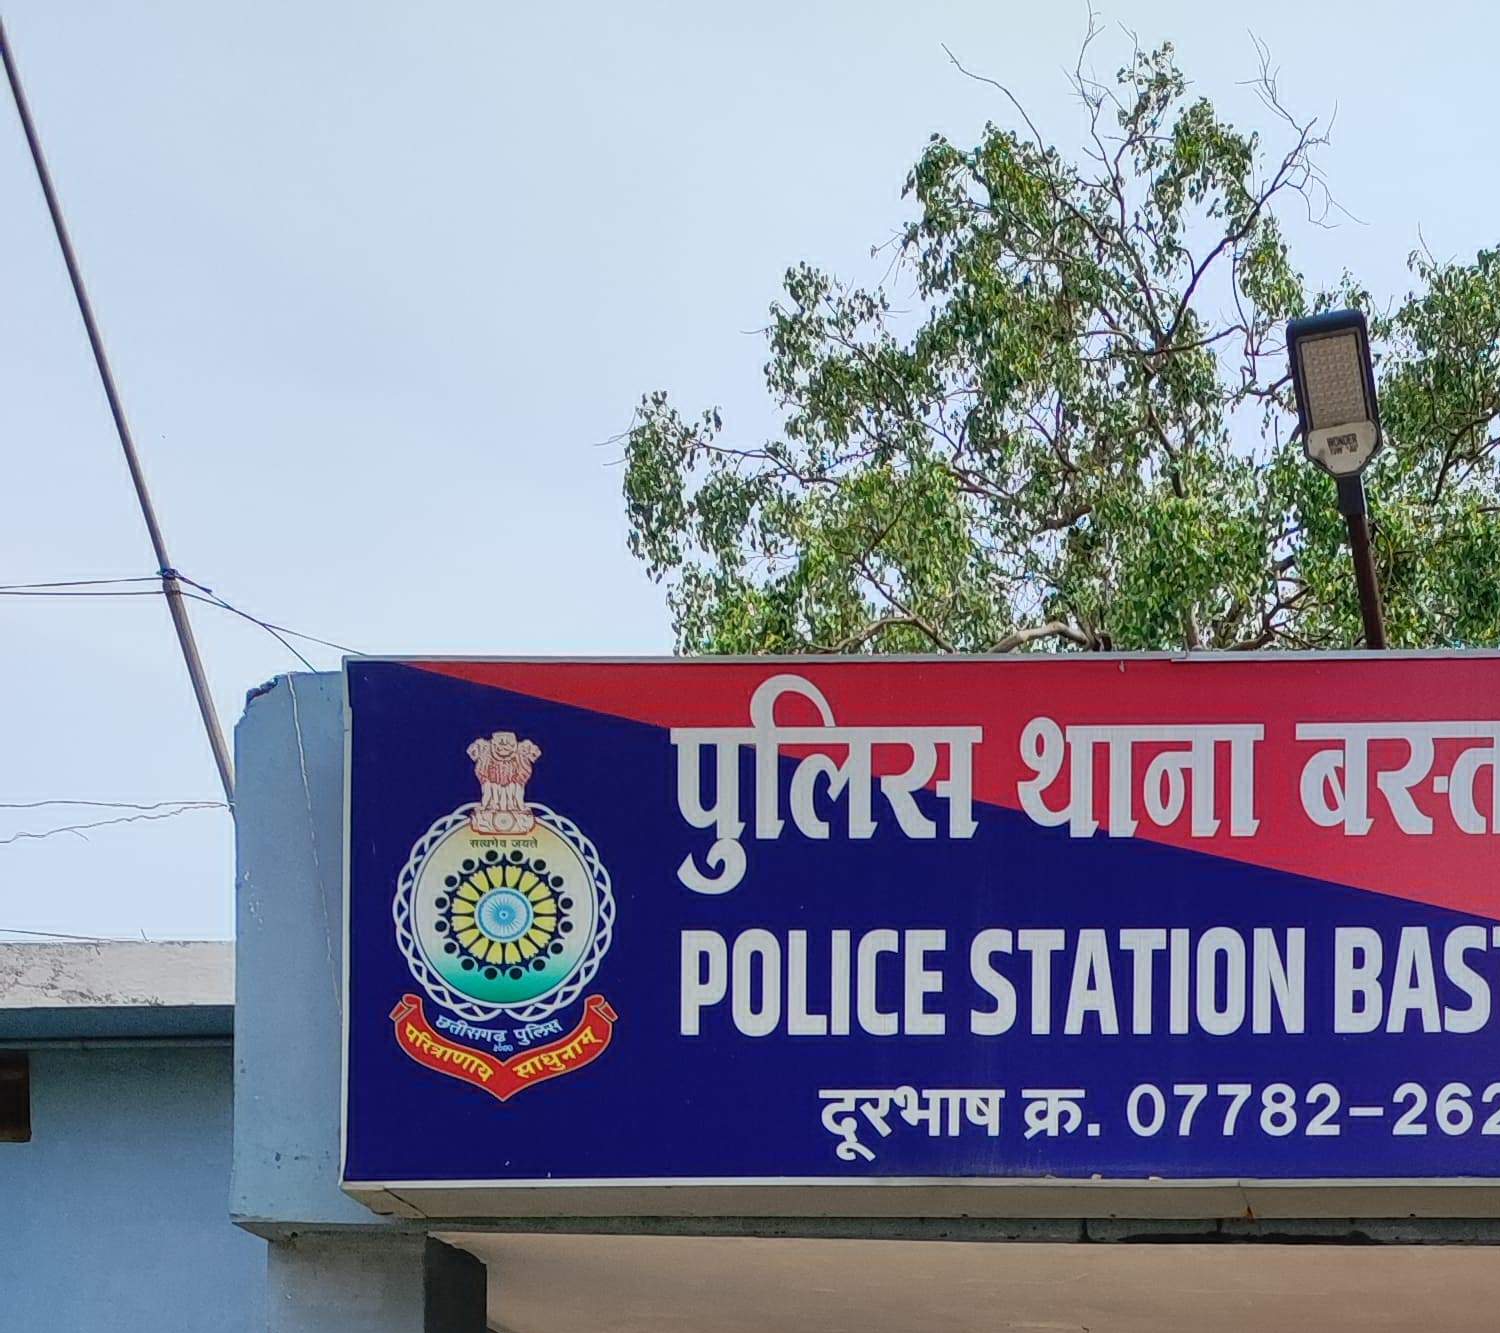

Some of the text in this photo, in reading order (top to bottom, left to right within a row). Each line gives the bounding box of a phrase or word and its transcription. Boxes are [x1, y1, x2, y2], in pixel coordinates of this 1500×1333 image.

[670, 675, 982, 894] पुलिस
[1018, 717, 1264, 837] थाना
[681, 929, 945, 1036] POLICE
[971, 927, 1305, 1035] STATION
[513, 1018, 563, 1046] पुलिस
[819, 1086, 1005, 1161] दूरभाष
[1022, 1090, 1099, 1139] क्र.
